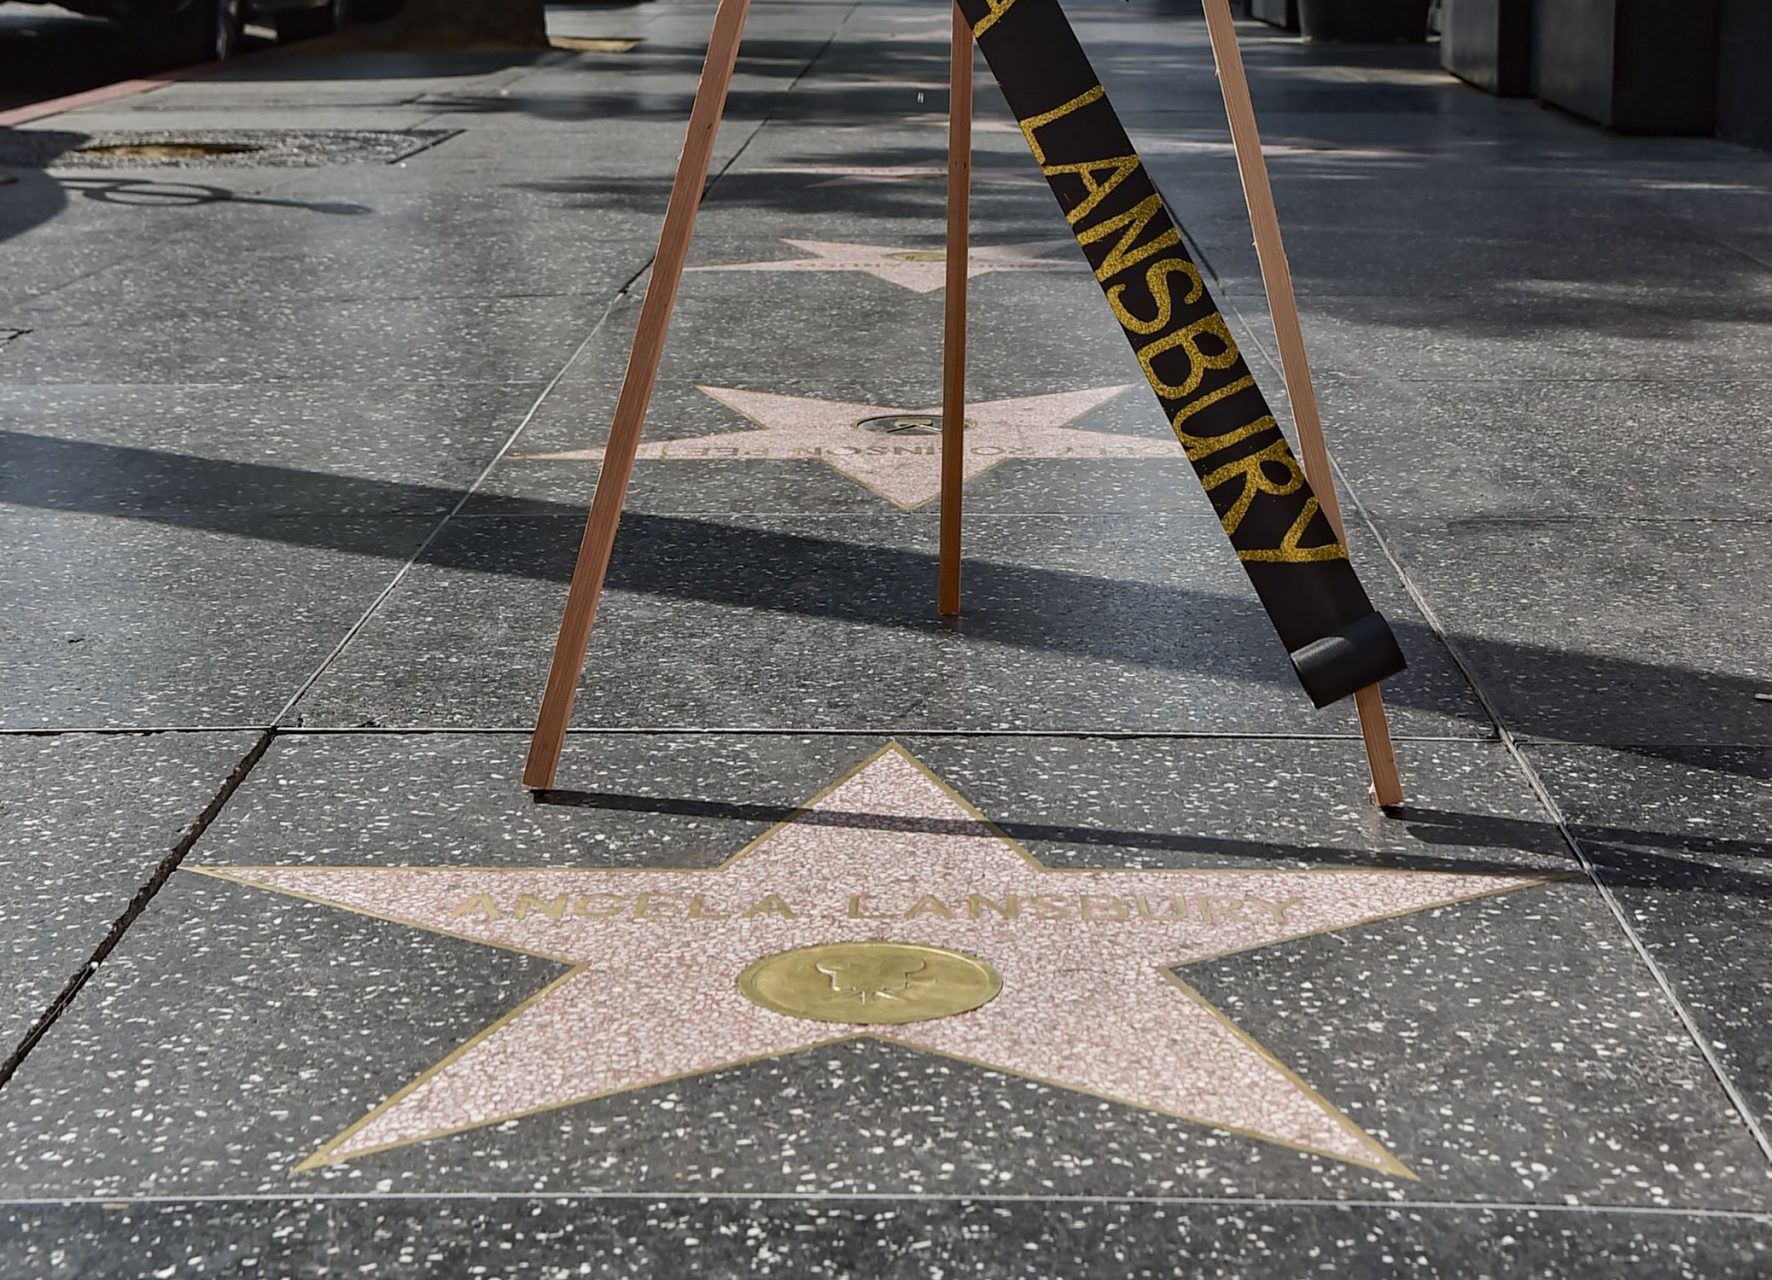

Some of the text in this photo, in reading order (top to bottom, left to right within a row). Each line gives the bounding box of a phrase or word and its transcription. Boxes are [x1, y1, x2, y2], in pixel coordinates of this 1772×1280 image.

[1019, 88, 1348, 562] LANSBURY
[792, 445, 1036, 457] ROINSON
[1055, 446, 1175, 457] OLLY
[449, 893, 1299, 920] ANGELA LANSBURY
